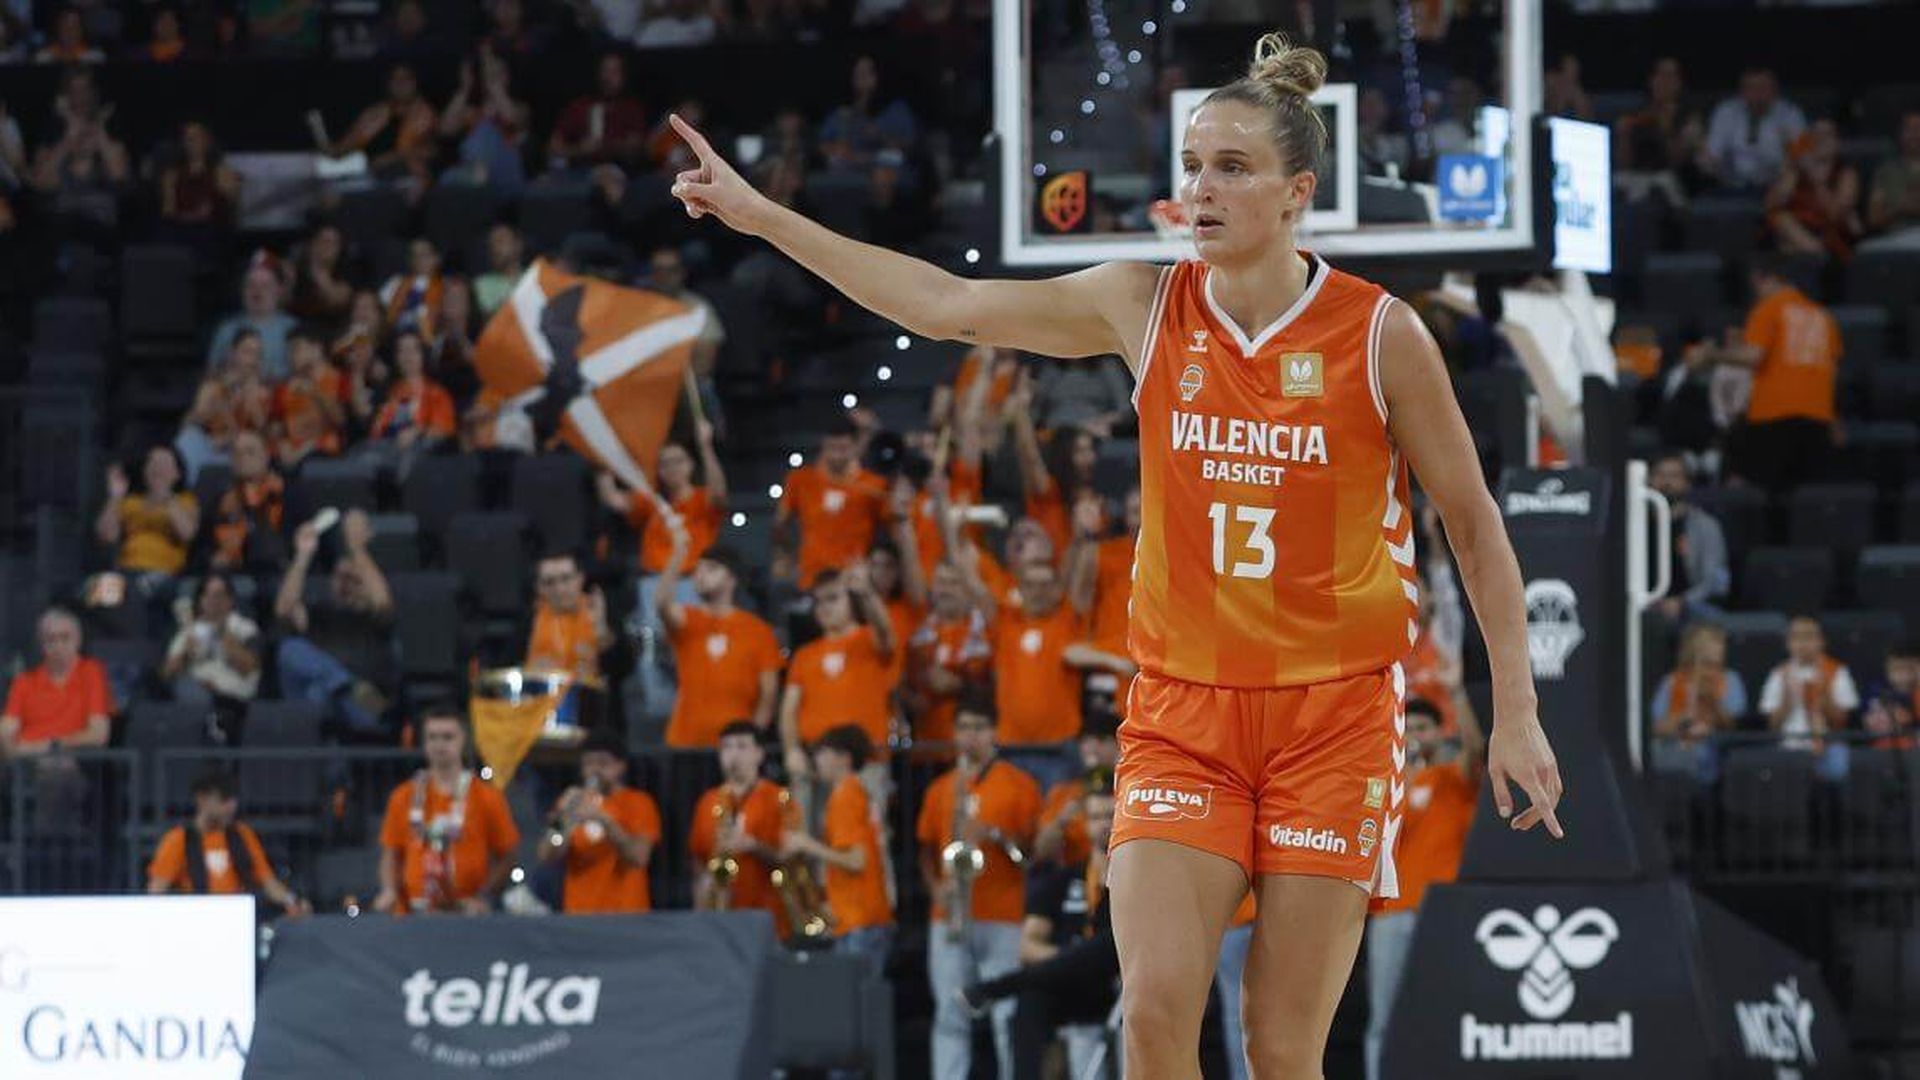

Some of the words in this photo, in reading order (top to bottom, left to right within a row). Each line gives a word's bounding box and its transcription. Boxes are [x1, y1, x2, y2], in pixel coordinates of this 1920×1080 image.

[1171, 410, 1329, 466] VALENCIA
[1202, 459, 1285, 487] BASKET
[1208, 502, 1277, 580] 13
[1127, 788, 1204, 807] PULEVA
[1269, 824, 1347, 855] Vitaldin
[402, 960, 601, 1027] teika
[23, 1003, 249, 1062] GANDIA
[1461, 1011, 1632, 1060] hummel
